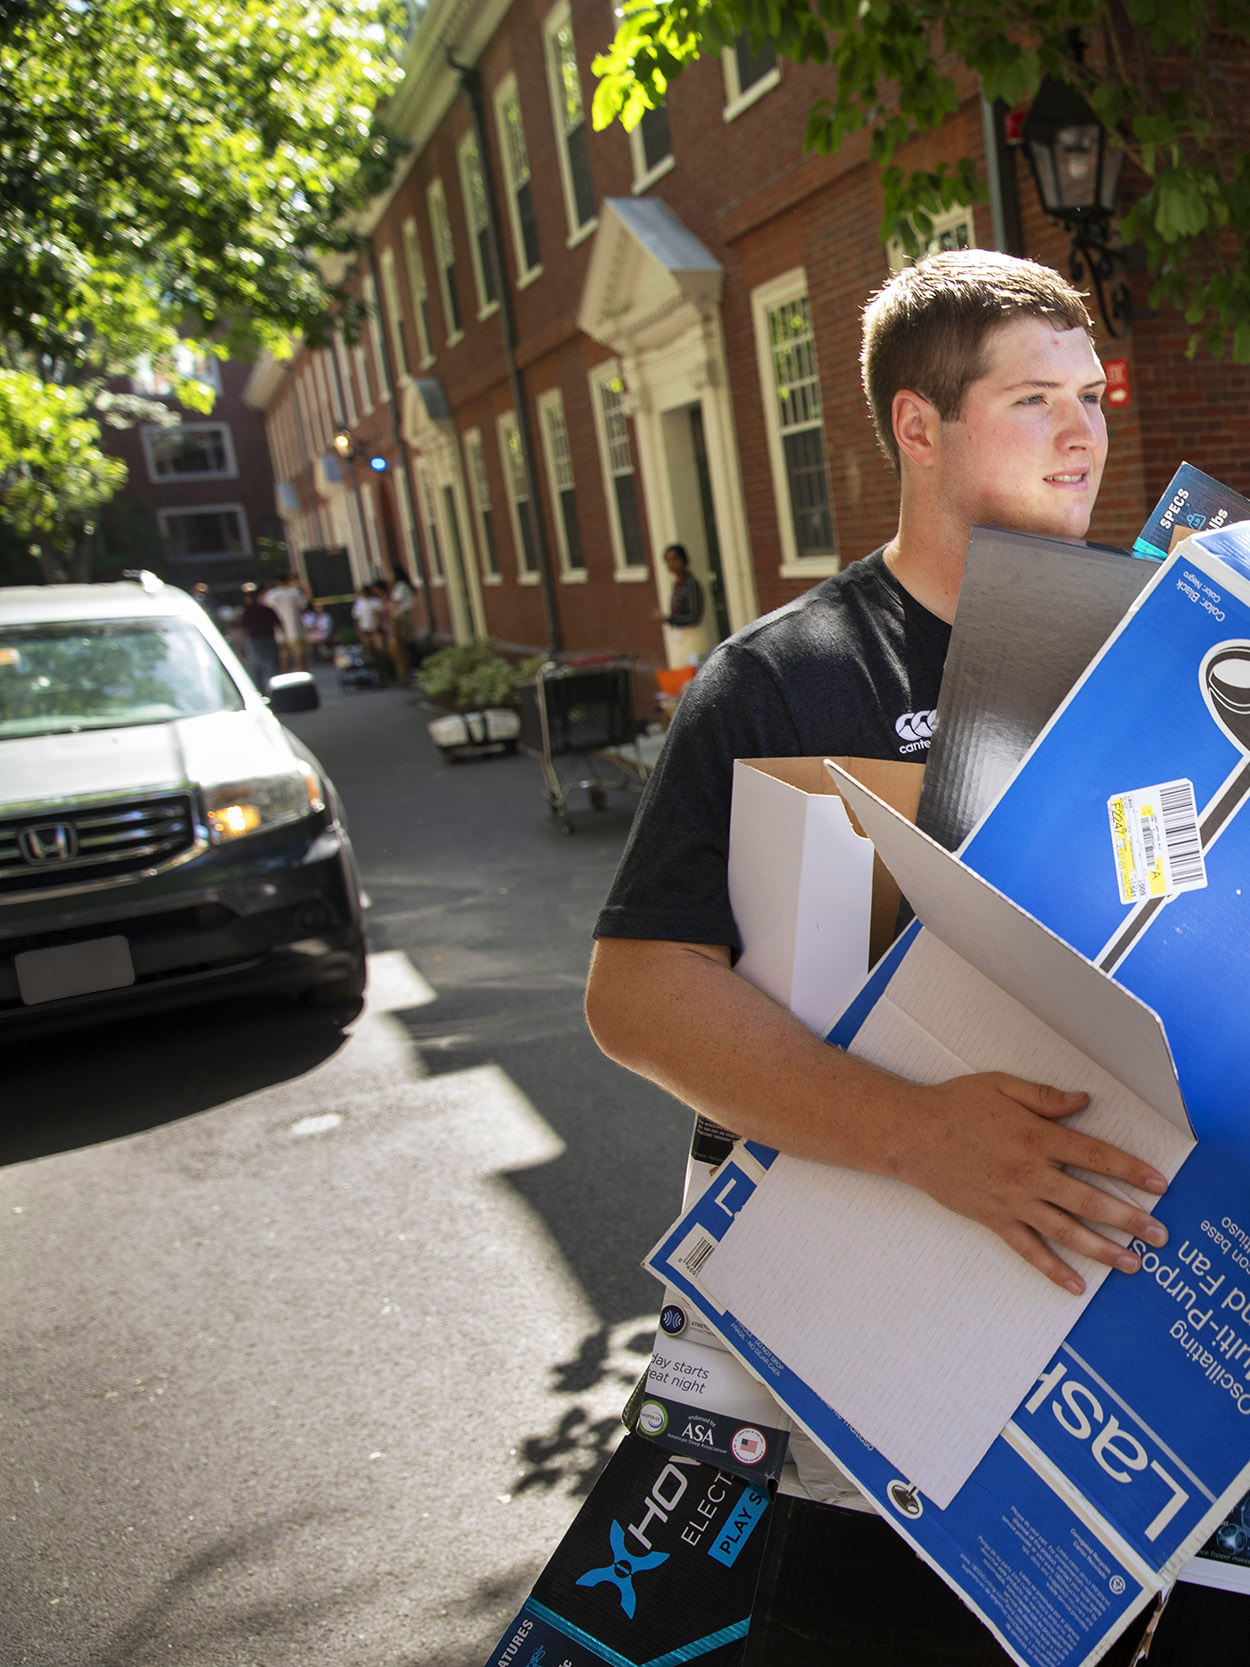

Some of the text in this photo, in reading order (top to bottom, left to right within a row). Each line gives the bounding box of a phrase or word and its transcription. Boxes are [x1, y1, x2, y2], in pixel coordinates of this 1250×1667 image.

[1158, 486, 1190, 529] SPECS
[1173, 578, 1227, 623] Color: Black
[1181, 567, 1222, 604] Color: Negro
[898, 739, 931, 754] cante
[1109, 802, 1124, 834] F2247
[1198, 1218, 1233, 1254] base
[1178, 1240, 1225, 1296] Fan
[671, 1377, 705, 1394] night
[673, 1362, 709, 1379] starts
[682, 1423, 713, 1445] ASA
[688, 1414, 709, 1423] endorsed
[667, 1432, 687, 1442] American
[687, 1438, 700, 1447] Sleep
[718, 1506, 756, 1555] PLAY
